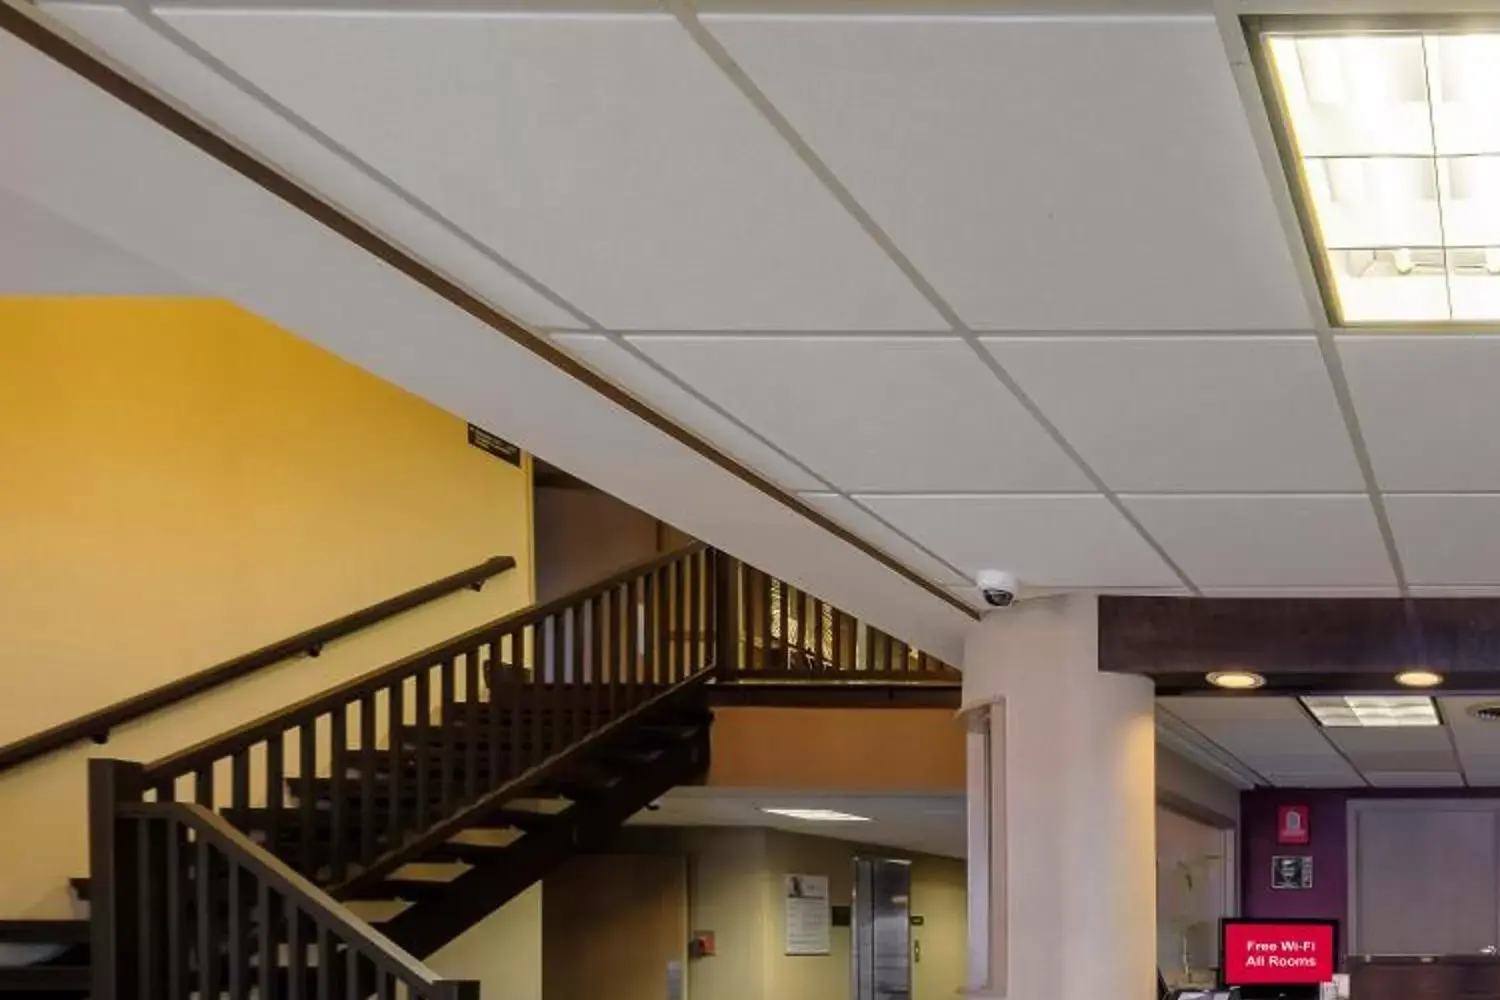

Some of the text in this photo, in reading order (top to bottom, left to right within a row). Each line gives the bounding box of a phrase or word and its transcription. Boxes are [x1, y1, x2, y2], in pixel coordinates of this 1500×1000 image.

[1246, 940, 1316, 952] Free Wi-Fi
[1245, 955, 1316, 967] All Rooms
